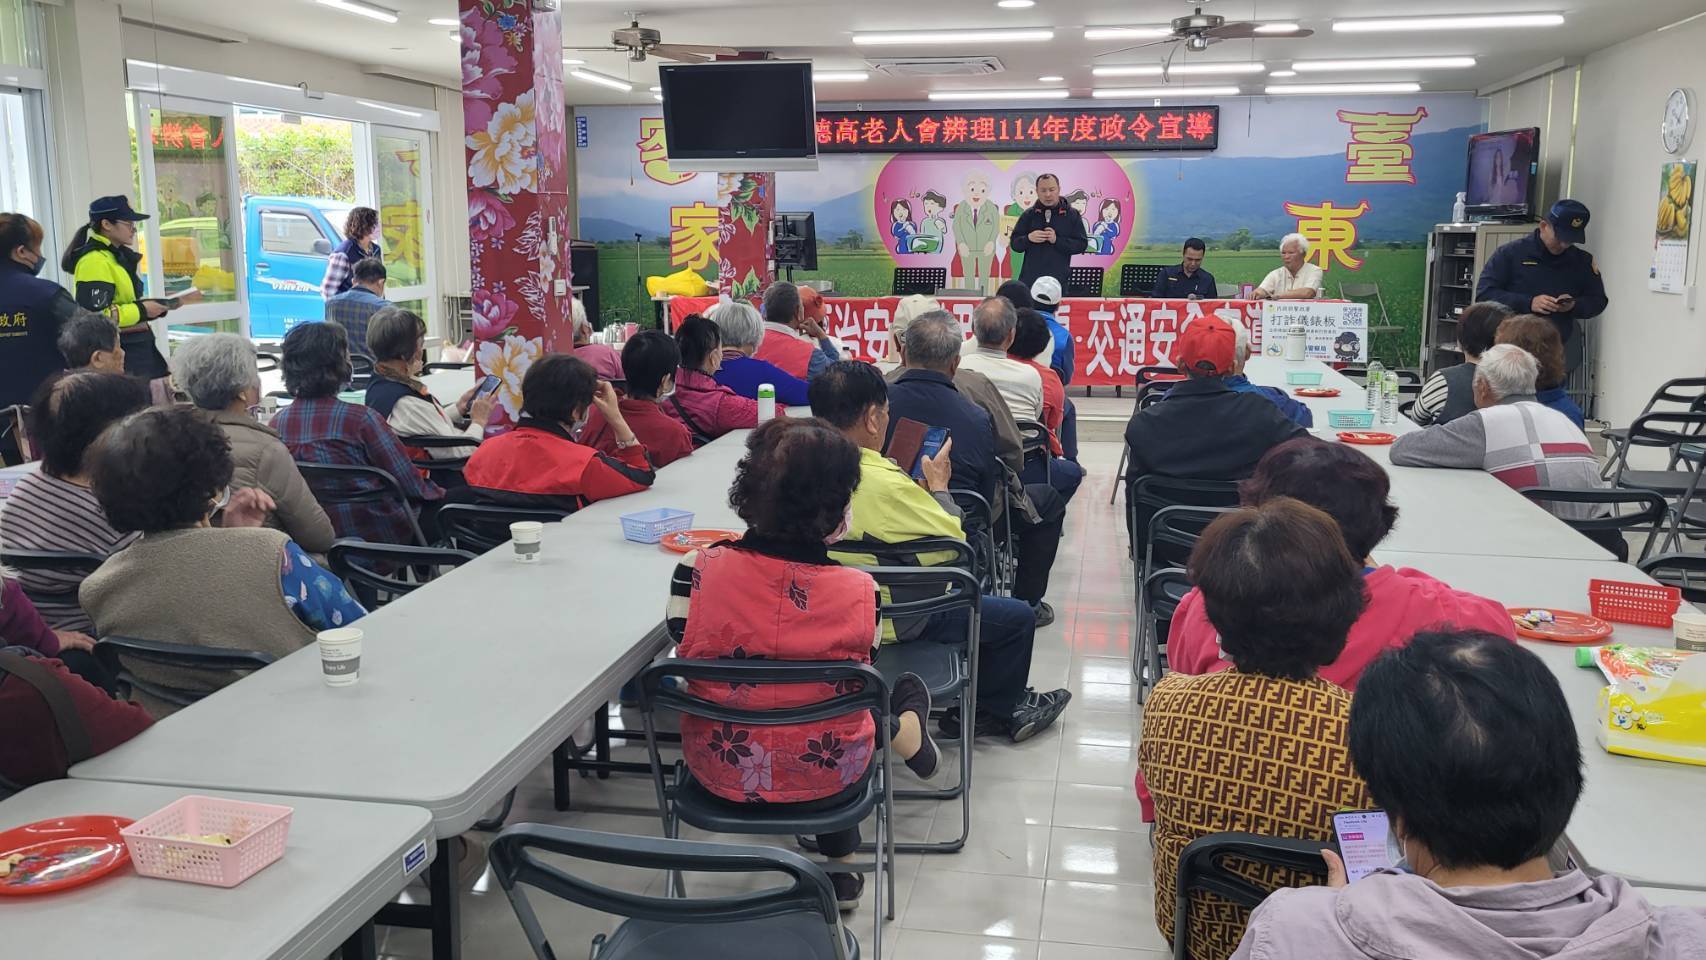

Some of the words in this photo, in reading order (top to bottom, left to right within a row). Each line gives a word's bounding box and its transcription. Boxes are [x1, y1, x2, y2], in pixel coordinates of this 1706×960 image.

[1271, 314, 1336, 327] 打詐儀錶板
